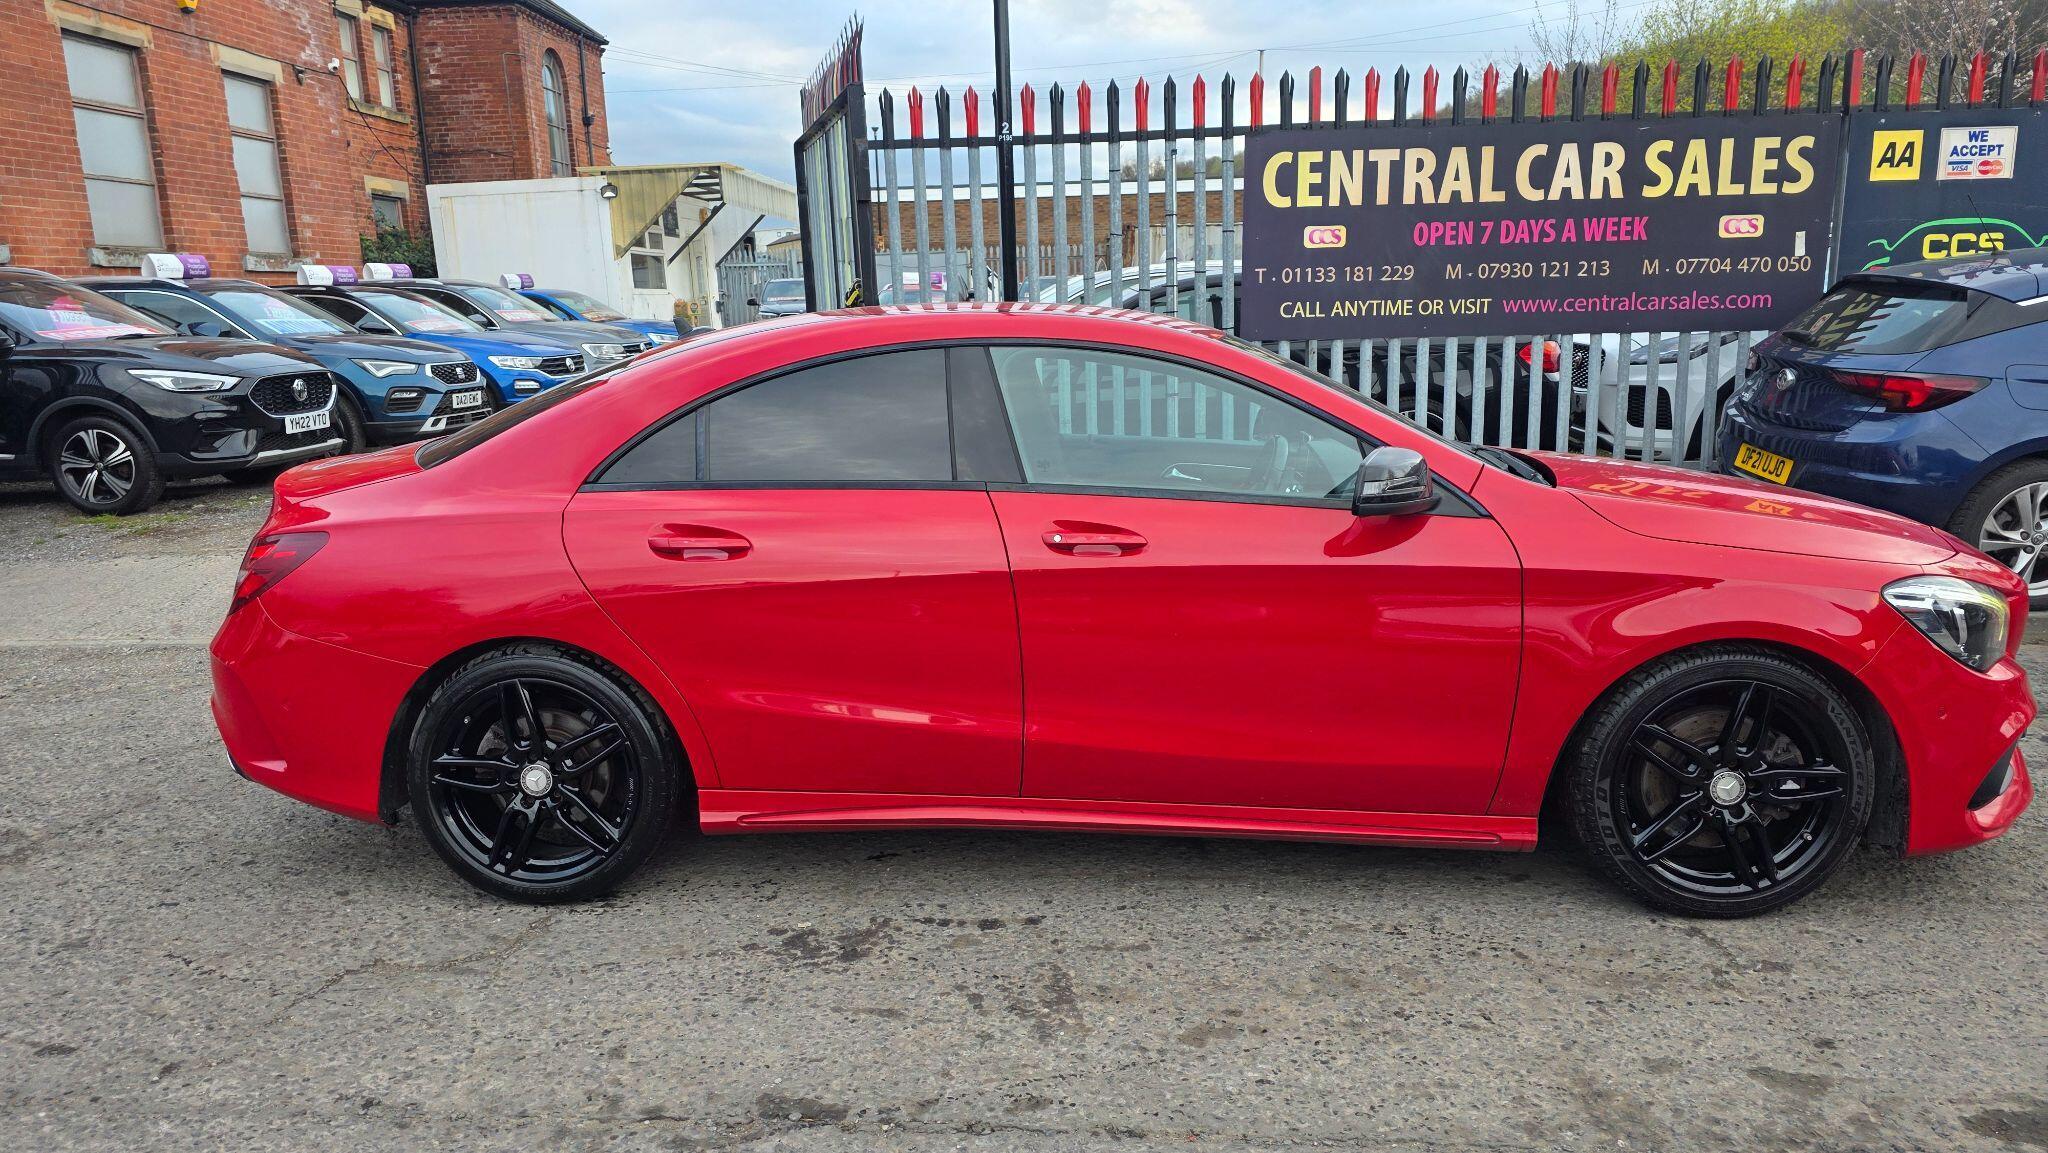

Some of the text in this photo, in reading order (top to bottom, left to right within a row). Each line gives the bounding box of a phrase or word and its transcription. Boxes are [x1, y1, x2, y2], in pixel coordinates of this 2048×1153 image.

[1002, 121, 1010, 134] 2
[1968, 130, 1989, 142] WE
[1877, 141, 1915, 168] AA
[1950, 144, 2004, 157] ACCEPT
[1263, 135, 1815, 208] CENTRAL CAR SALES
[1413, 216, 1649, 246] OPEN 7 DAYS A WEEK
[1922, 232, 2005, 259] CCS
[1282, 267, 1336, 283] 01133
[1343, 266, 1373, 282] 181
[1379, 265, 1415, 281] 229
[1478, 262, 1533, 279] 07930
[1540, 261, 1569, 277] 121
[1577, 260, 1610, 277] 213
[1675, 258, 1732, 274] 07704
[1738, 256, 1772, 273] 470
[1777, 255, 1811, 272] 050
[1280, 290, 1772, 318] CALL ANYTIME OR VISIT www.centralcarsales.com
[290, 413, 327, 430] YH22 VTO
[1761, 454, 1786, 477] UJO
